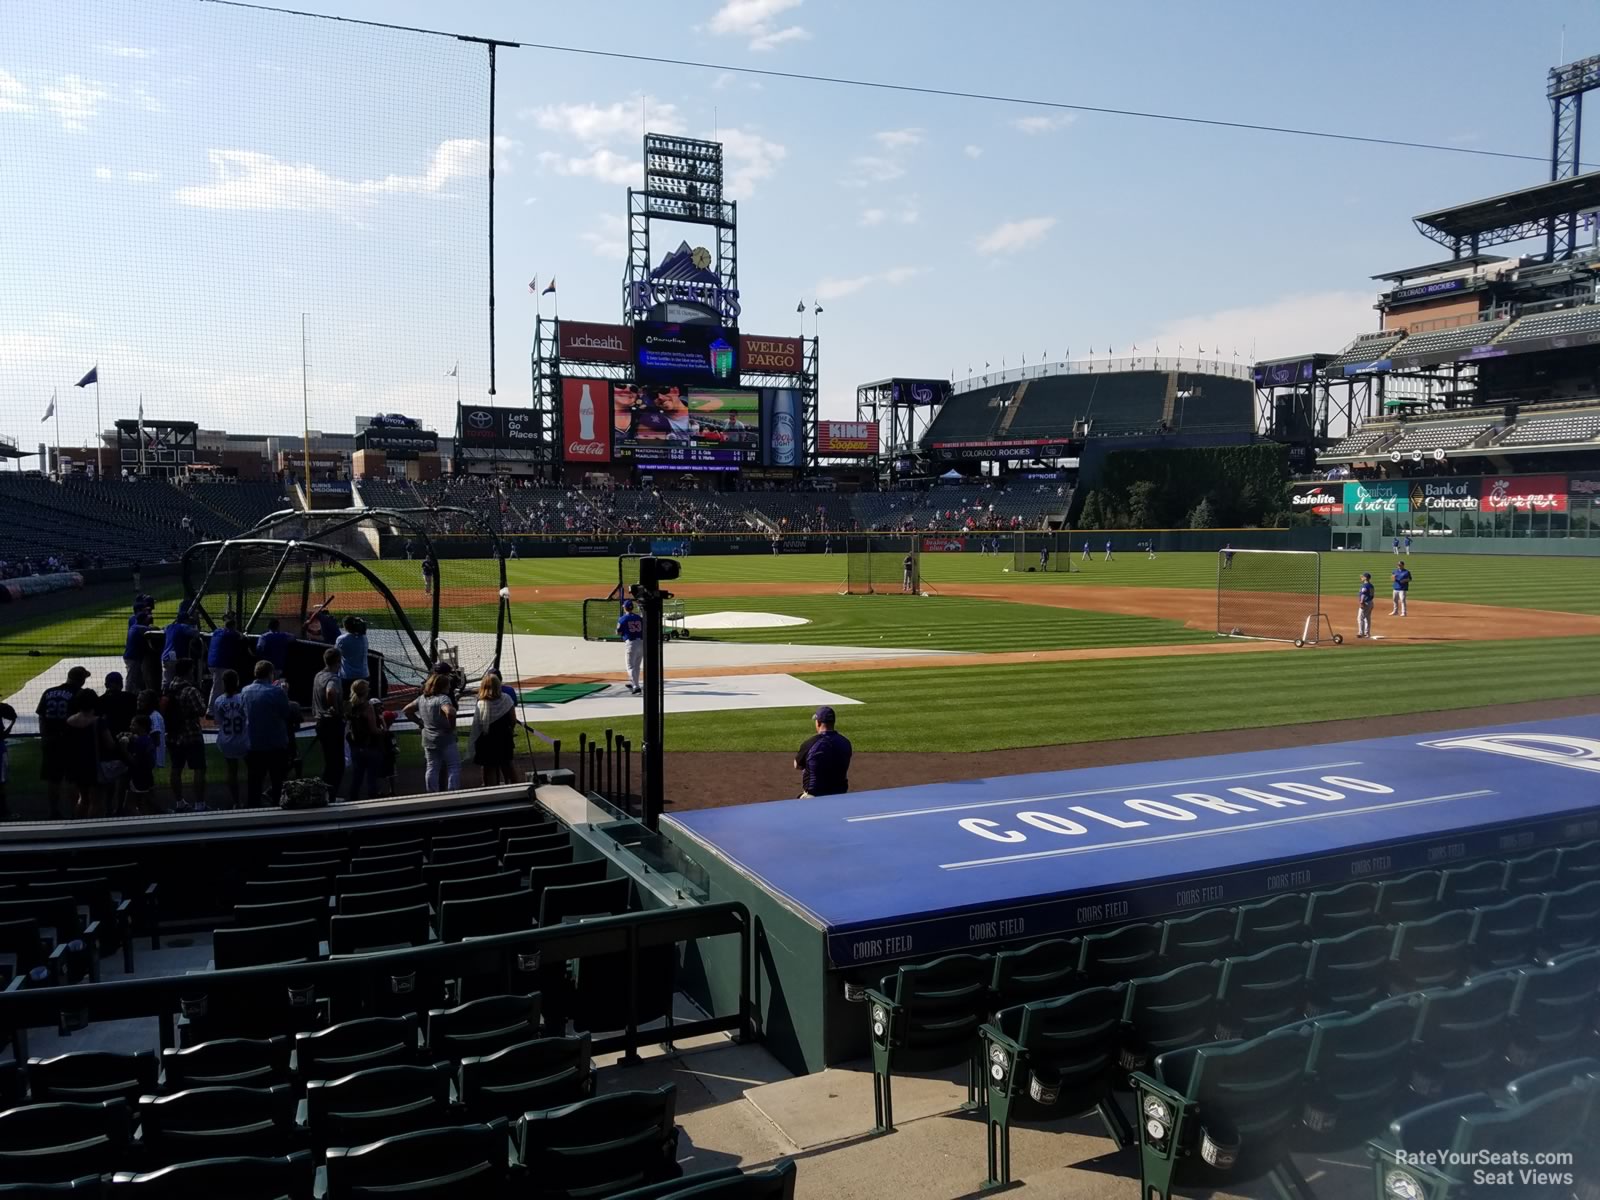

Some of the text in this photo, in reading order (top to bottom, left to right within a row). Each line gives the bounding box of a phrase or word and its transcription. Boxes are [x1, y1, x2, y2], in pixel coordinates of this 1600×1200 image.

[1397, 281, 1456, 298] COLORADO ROCKIES
[630, 281, 742, 319] ROCKIES
[570, 332, 623, 350] uchealth
[746, 340, 795, 355] WELLS
[747, 353, 795, 367] FARGO
[381, 416, 405, 425] TOYOTA
[508, 413, 529, 422] Let's
[508, 421, 521, 430] Go
[829, 423, 868, 438] KING
[509, 430, 538, 439] Places
[370, 437, 435, 448] TUNDRA
[961, 448, 1031, 458] COLORADO ROCKIES
[1357, 484, 1393, 498] Comfort
[1425, 481, 1469, 495] Bank of
[1292, 494, 1336, 505] Safelite
[1355, 494, 1398, 511] dental
[1425, 495, 1479, 509] Colorado
[224, 717, 242, 735] 28
[957, 775, 1395, 843] COLORADO
[1372, 856, 1391, 872] FIELD
[1267, 870, 1311, 890] COORS FIELD
[1176, 885, 1224, 907] COORS FIELD
[1077, 901, 1128, 923] COORS FIELD
[969, 917, 1025, 941] COORS FIELD
[853, 935, 912, 960] COORS FIELD
